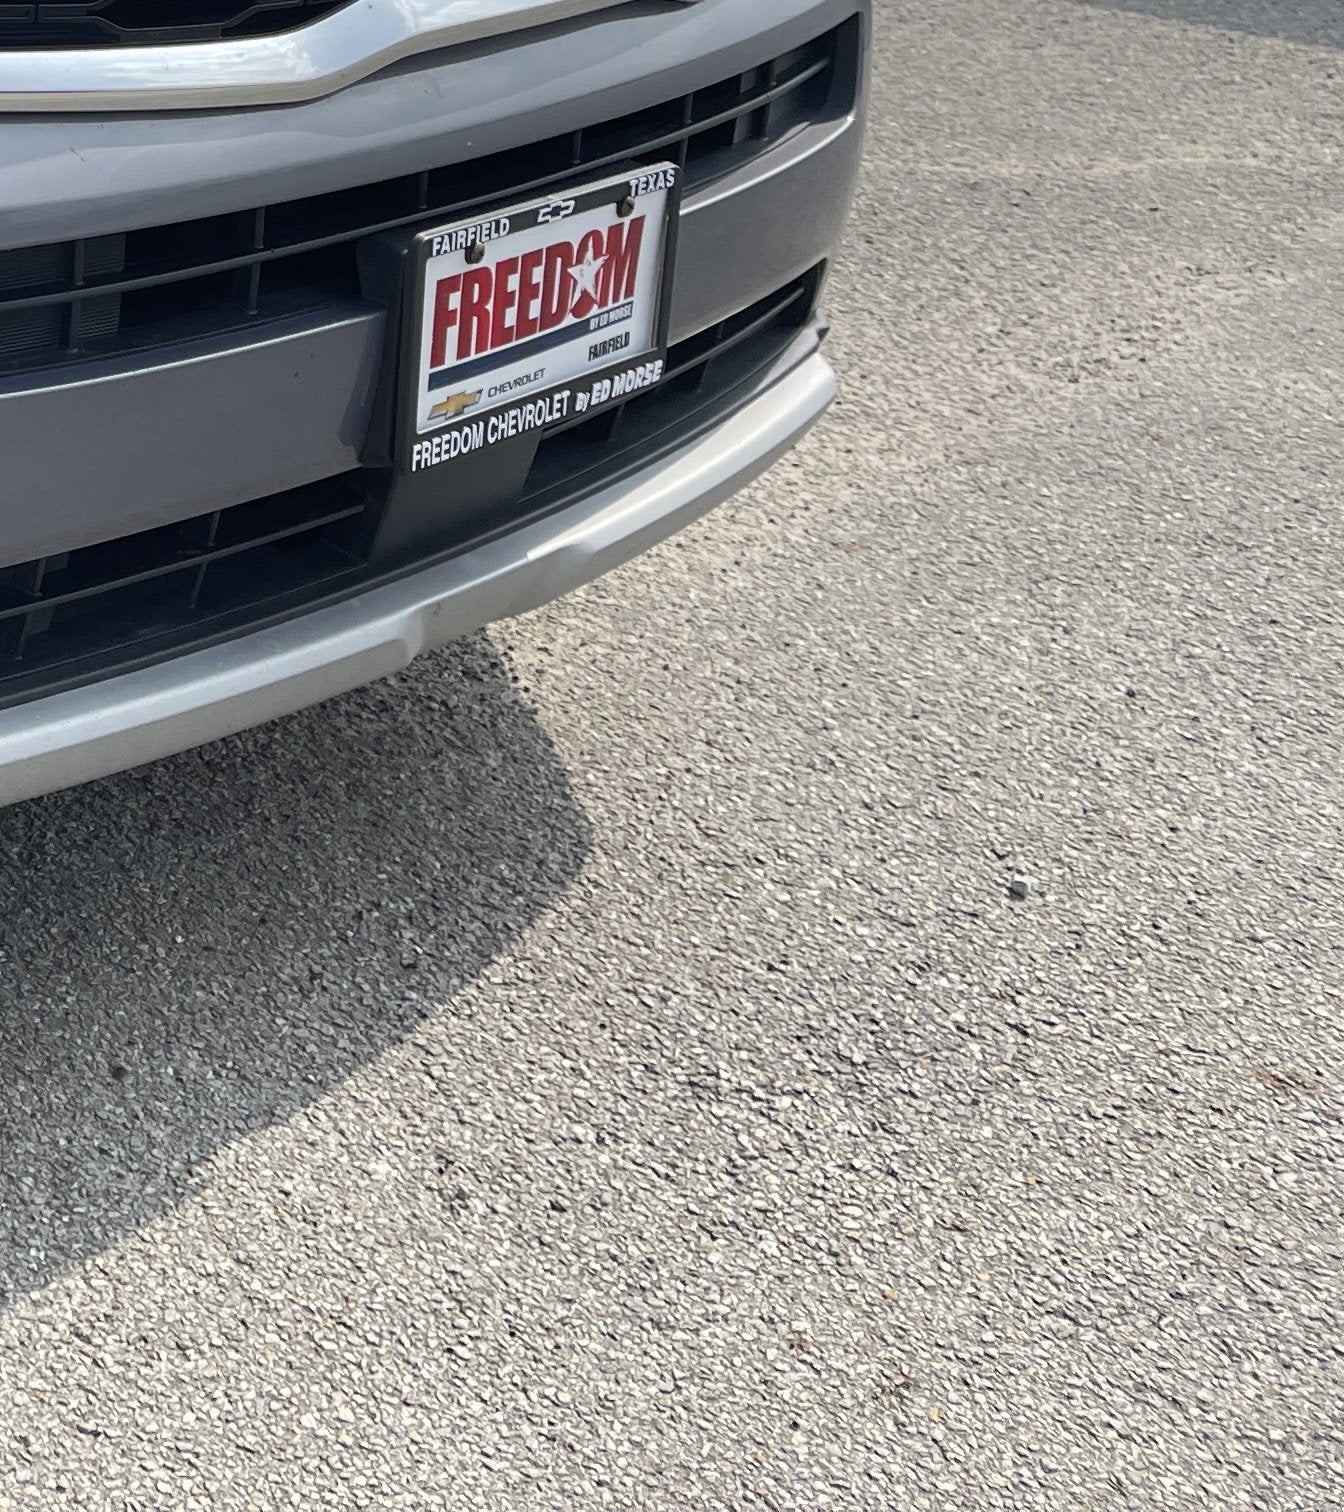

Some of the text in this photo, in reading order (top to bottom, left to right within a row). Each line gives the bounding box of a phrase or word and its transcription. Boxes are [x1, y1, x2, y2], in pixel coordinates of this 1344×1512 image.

[432, 169, 675, 257] FAIRFIELD TEXAS
[429, 214, 647, 370] FREEDOM
[487, 368, 547, 397] CHEVROLET
[588, 332, 631, 362] FAIRFIELD
[412, 421, 485, 472] FREEDOM
[487, 390, 571, 444] CHEVROLET
[591, 379, 612, 406] ED
[611, 359, 664, 398] MORSE
